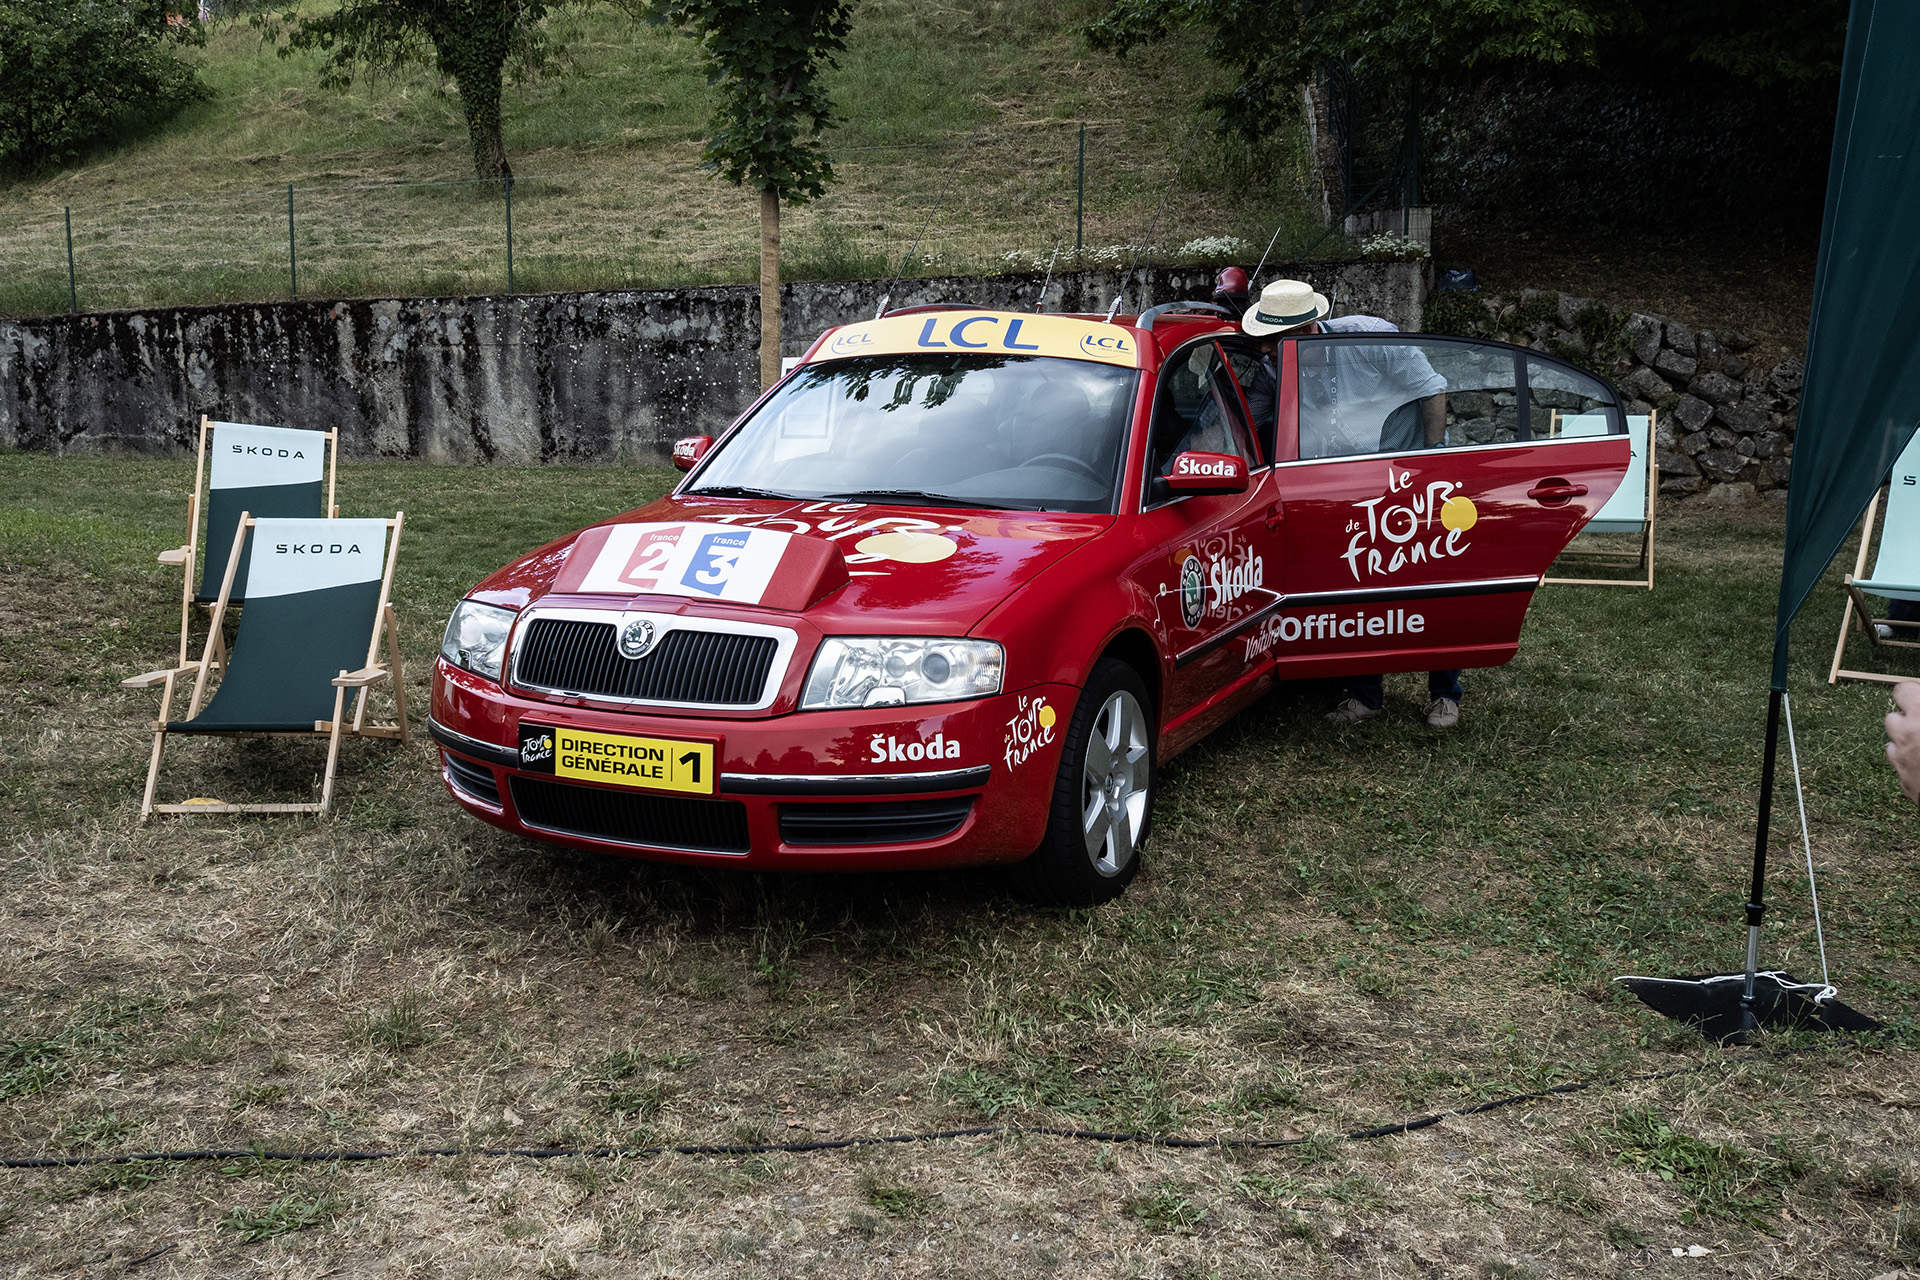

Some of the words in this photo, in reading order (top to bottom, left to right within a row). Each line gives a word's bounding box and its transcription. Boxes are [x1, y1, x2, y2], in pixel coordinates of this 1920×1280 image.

[836, 333, 872, 346] LCL
[917, 316, 1039, 350] LCL
[1085, 335, 1129, 351] LCL
[1178, 457, 1236, 477] Škoda
[649, 533, 680, 542] france
[1345, 519, 1359, 533] de
[712, 535, 746, 547] france
[627, 541, 677, 579] 2
[695, 545, 738, 585] 3
[1210, 544, 1263, 610] Škoda
[1279, 608, 1425, 642] Officielle
[1243, 626, 1281, 663] Voiture
[561, 738, 664, 762] DIRECTION
[870, 733, 961, 763] Škoda
[561, 754, 664, 779] GÉNÉRALE
[678, 751, 701, 783] 1
